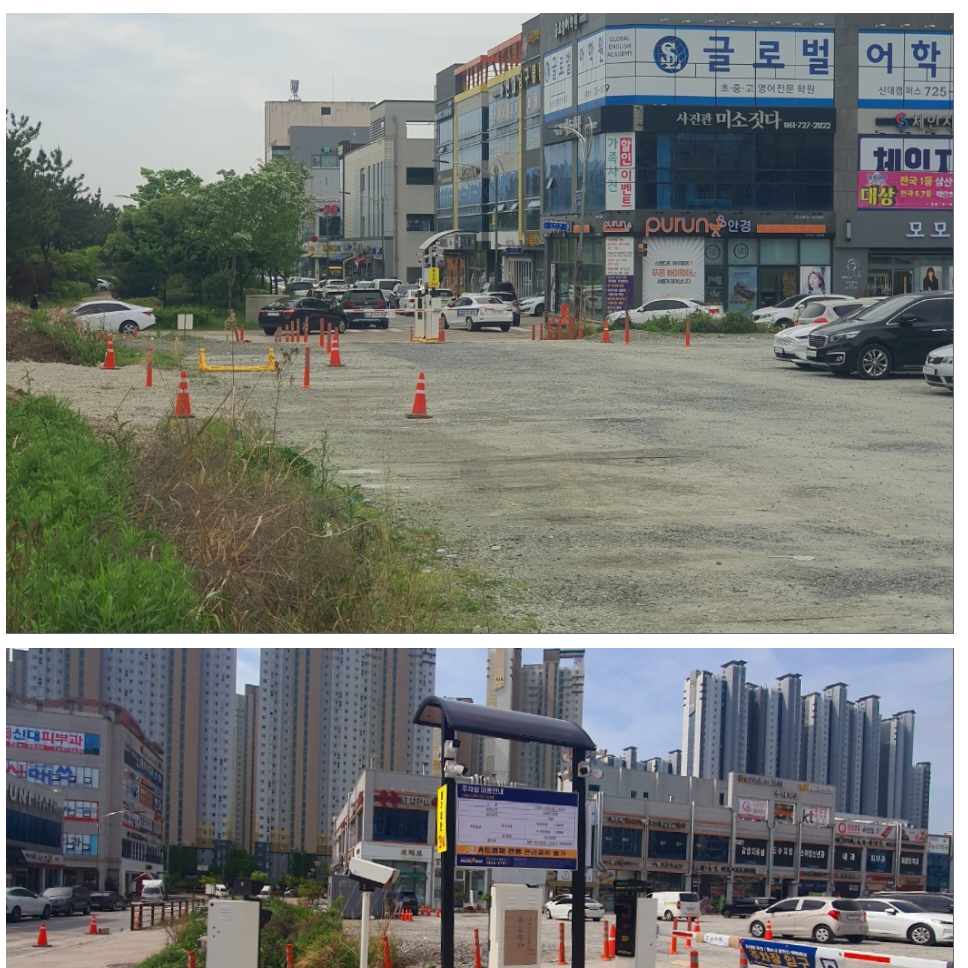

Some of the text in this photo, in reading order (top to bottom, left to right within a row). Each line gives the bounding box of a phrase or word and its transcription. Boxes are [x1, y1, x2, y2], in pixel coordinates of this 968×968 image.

[703, 36, 829, 75] 글로벌
[757, 83, 795, 94] 영어전문
[797, 84, 815, 94] 학원
[878, 86, 922, 96] 신대캠퍼스
[676, 109, 831, 130] 사진관 미소짓다 061-727-2022
[607, 138, 618, 193] 가족사진
[620, 137, 632, 207] 할인 이벤트
[900, 176, 917, 186] 전국
[920, 176, 933, 186] 1등
[860, 186, 895, 206] 대상
[603, 220, 626, 228] purun
[645, 217, 751, 237] purun 안경
[13, 728, 83, 747] 신대피부과
[749, 950, 810, 968] 주차장 입구
